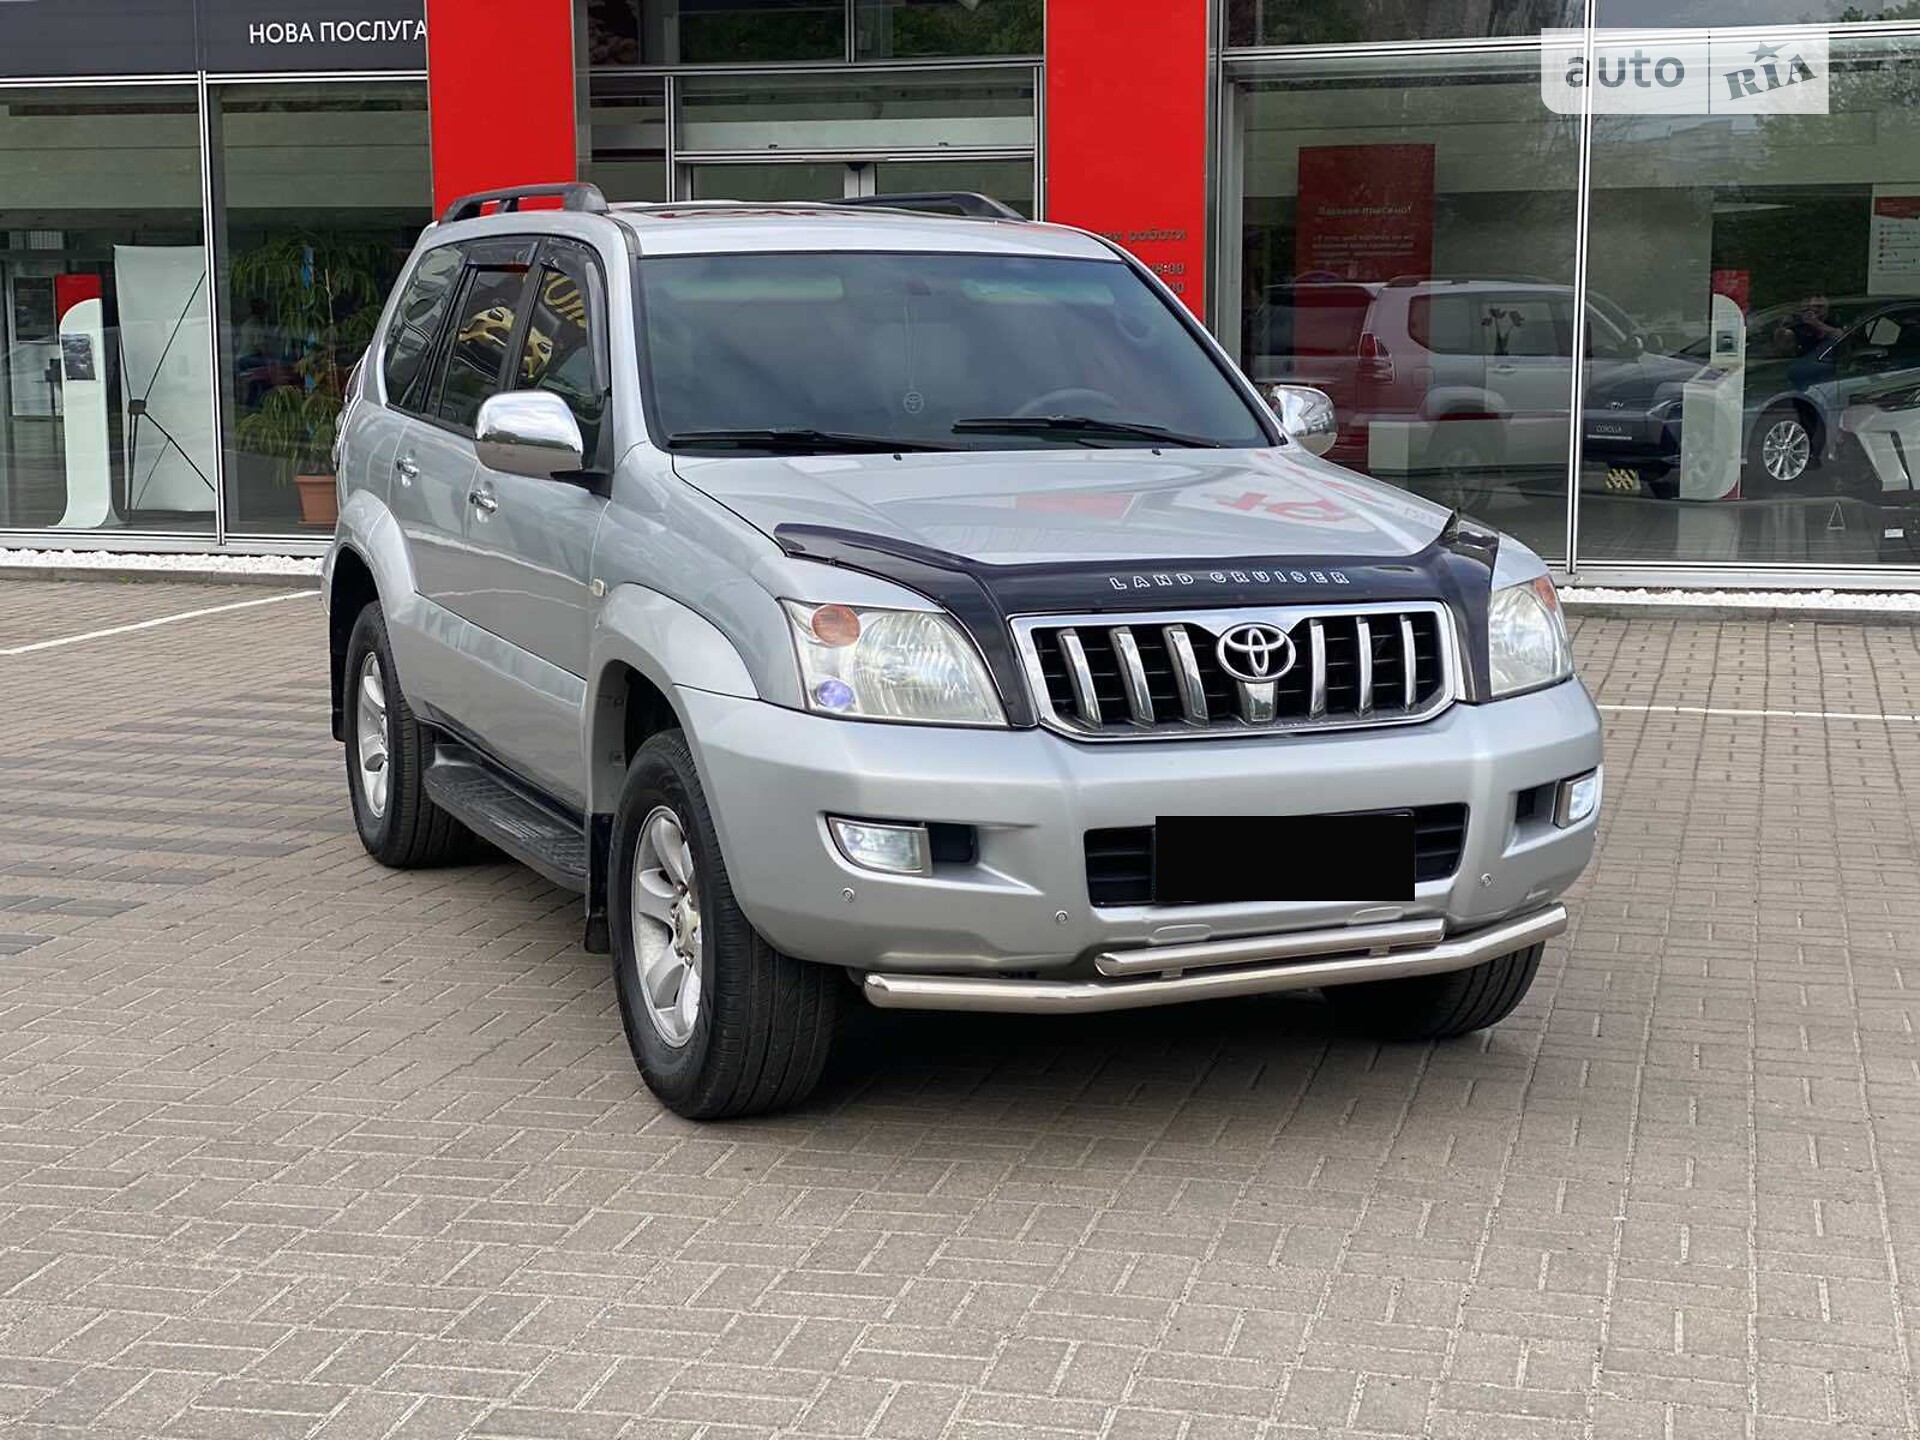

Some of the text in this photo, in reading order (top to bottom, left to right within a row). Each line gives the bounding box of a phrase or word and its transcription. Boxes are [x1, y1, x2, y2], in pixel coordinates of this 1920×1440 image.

[249, 20, 427, 44] НОВА ПОСЛУГА
[1109, 571, 1350, 590] LAND CRUISER
